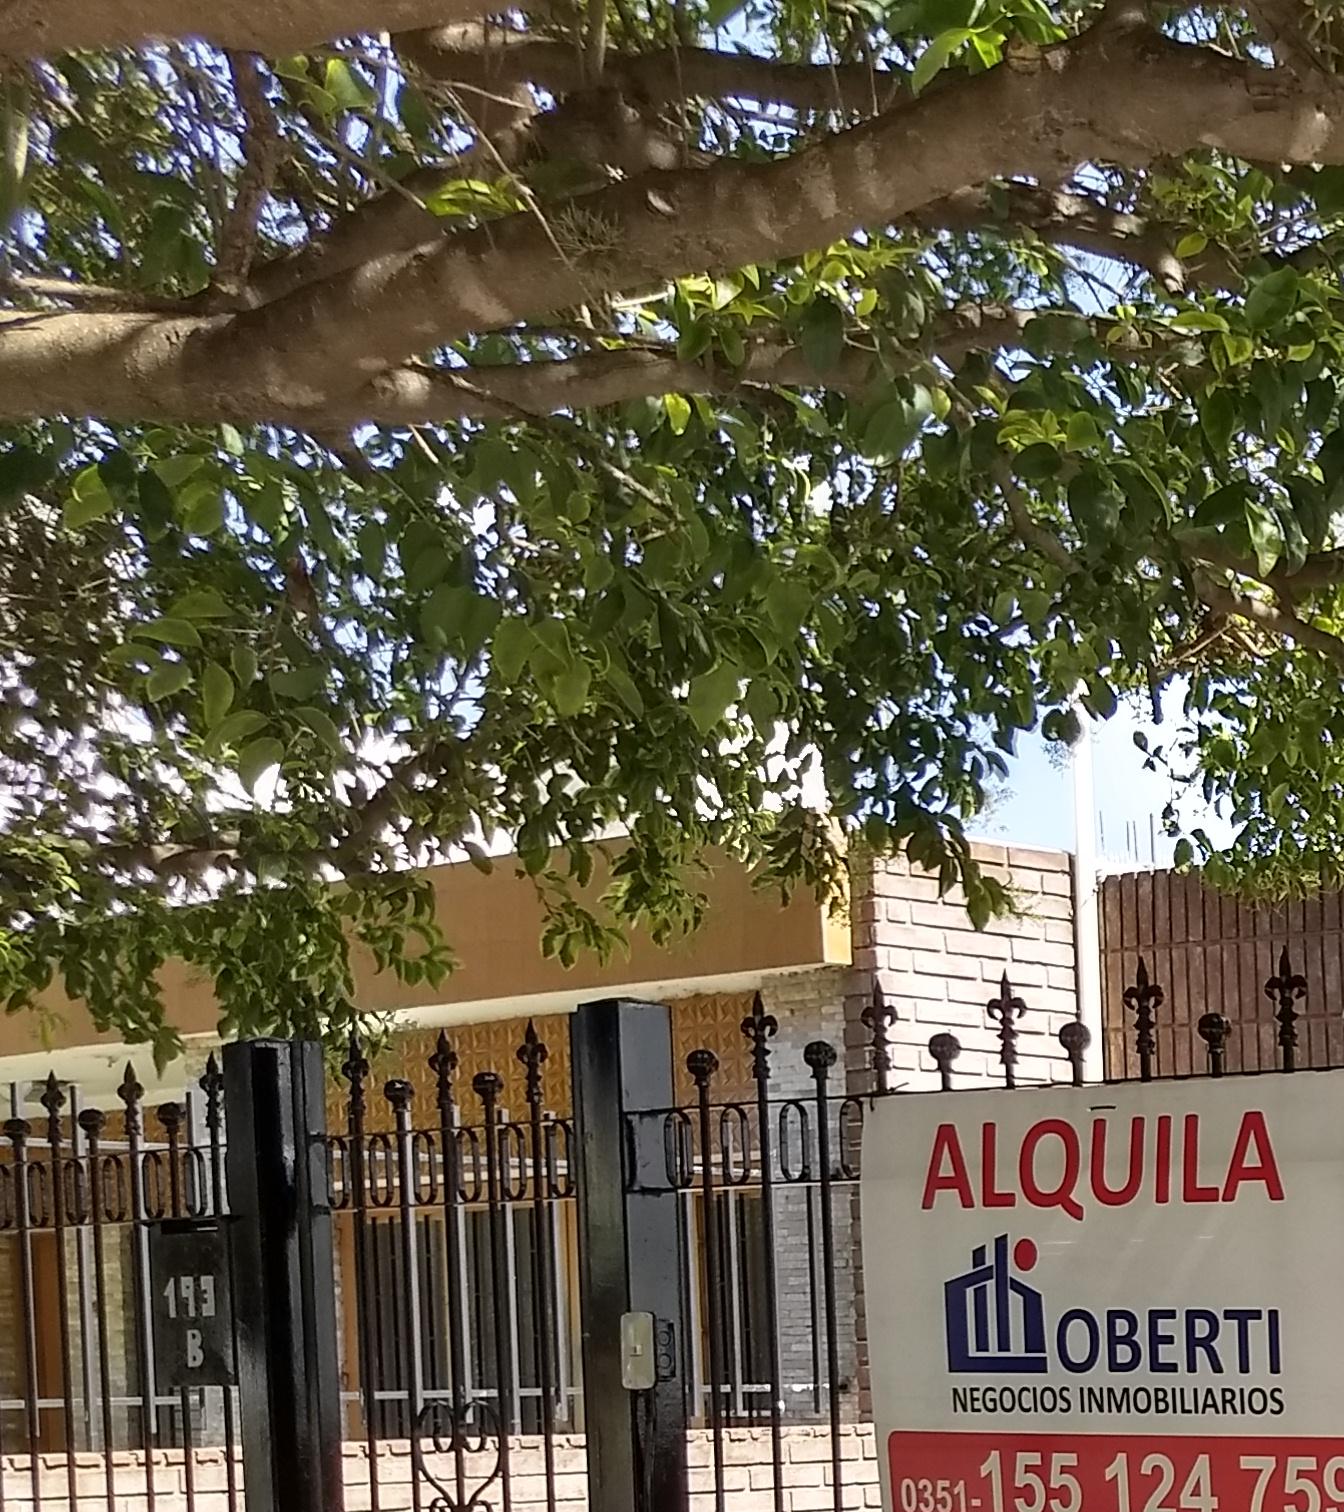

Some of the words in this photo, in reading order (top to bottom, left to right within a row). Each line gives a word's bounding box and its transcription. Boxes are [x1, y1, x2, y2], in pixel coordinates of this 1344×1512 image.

[921, 1110, 1286, 1221] ALQUILA
[163, 1275, 216, 1319] 193
[186, 1328, 205, 1368] B
[951, 1385, 1073, 1415] NEGOCIOS
[1078, 1386, 1286, 1416] INMOBILIARIOS
